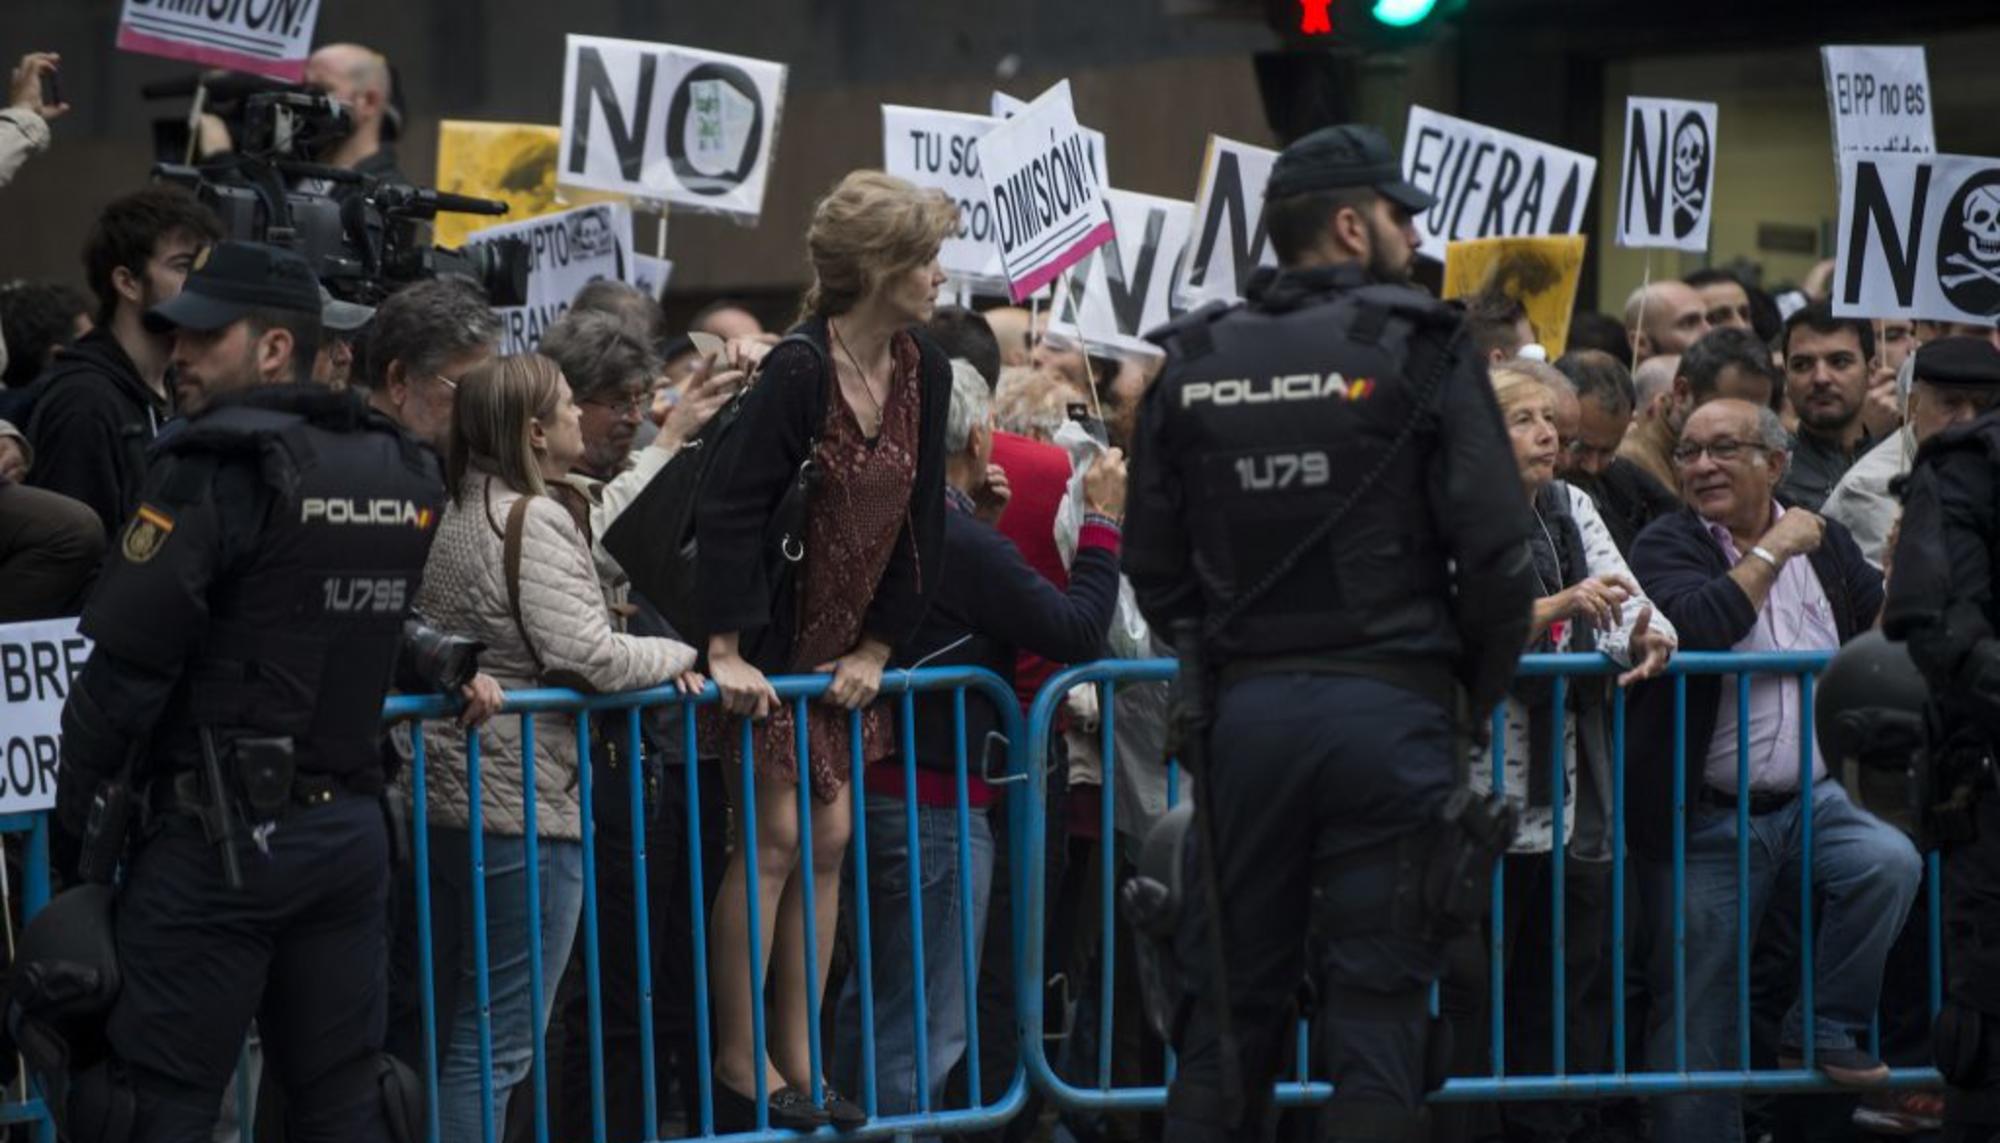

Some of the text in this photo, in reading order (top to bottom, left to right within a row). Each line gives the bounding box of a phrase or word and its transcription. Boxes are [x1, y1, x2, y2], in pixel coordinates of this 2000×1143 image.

[1853, 74, 1875, 116] PP
[1880, 84, 1900, 115] no
[1905, 83, 1925, 116] es
[568, 46, 763, 196] NO
[910, 130, 984, 178] TU SO
[1625, 108, 1709, 239] NO
[993, 126, 1091, 255] DIMISIÓN!
[954, 199, 997, 243] CO
[1181, 372, 1349, 408] POLICIA
[1235, 452, 1330, 490] 1U79
[302, 498, 418, 523] POLICIA
